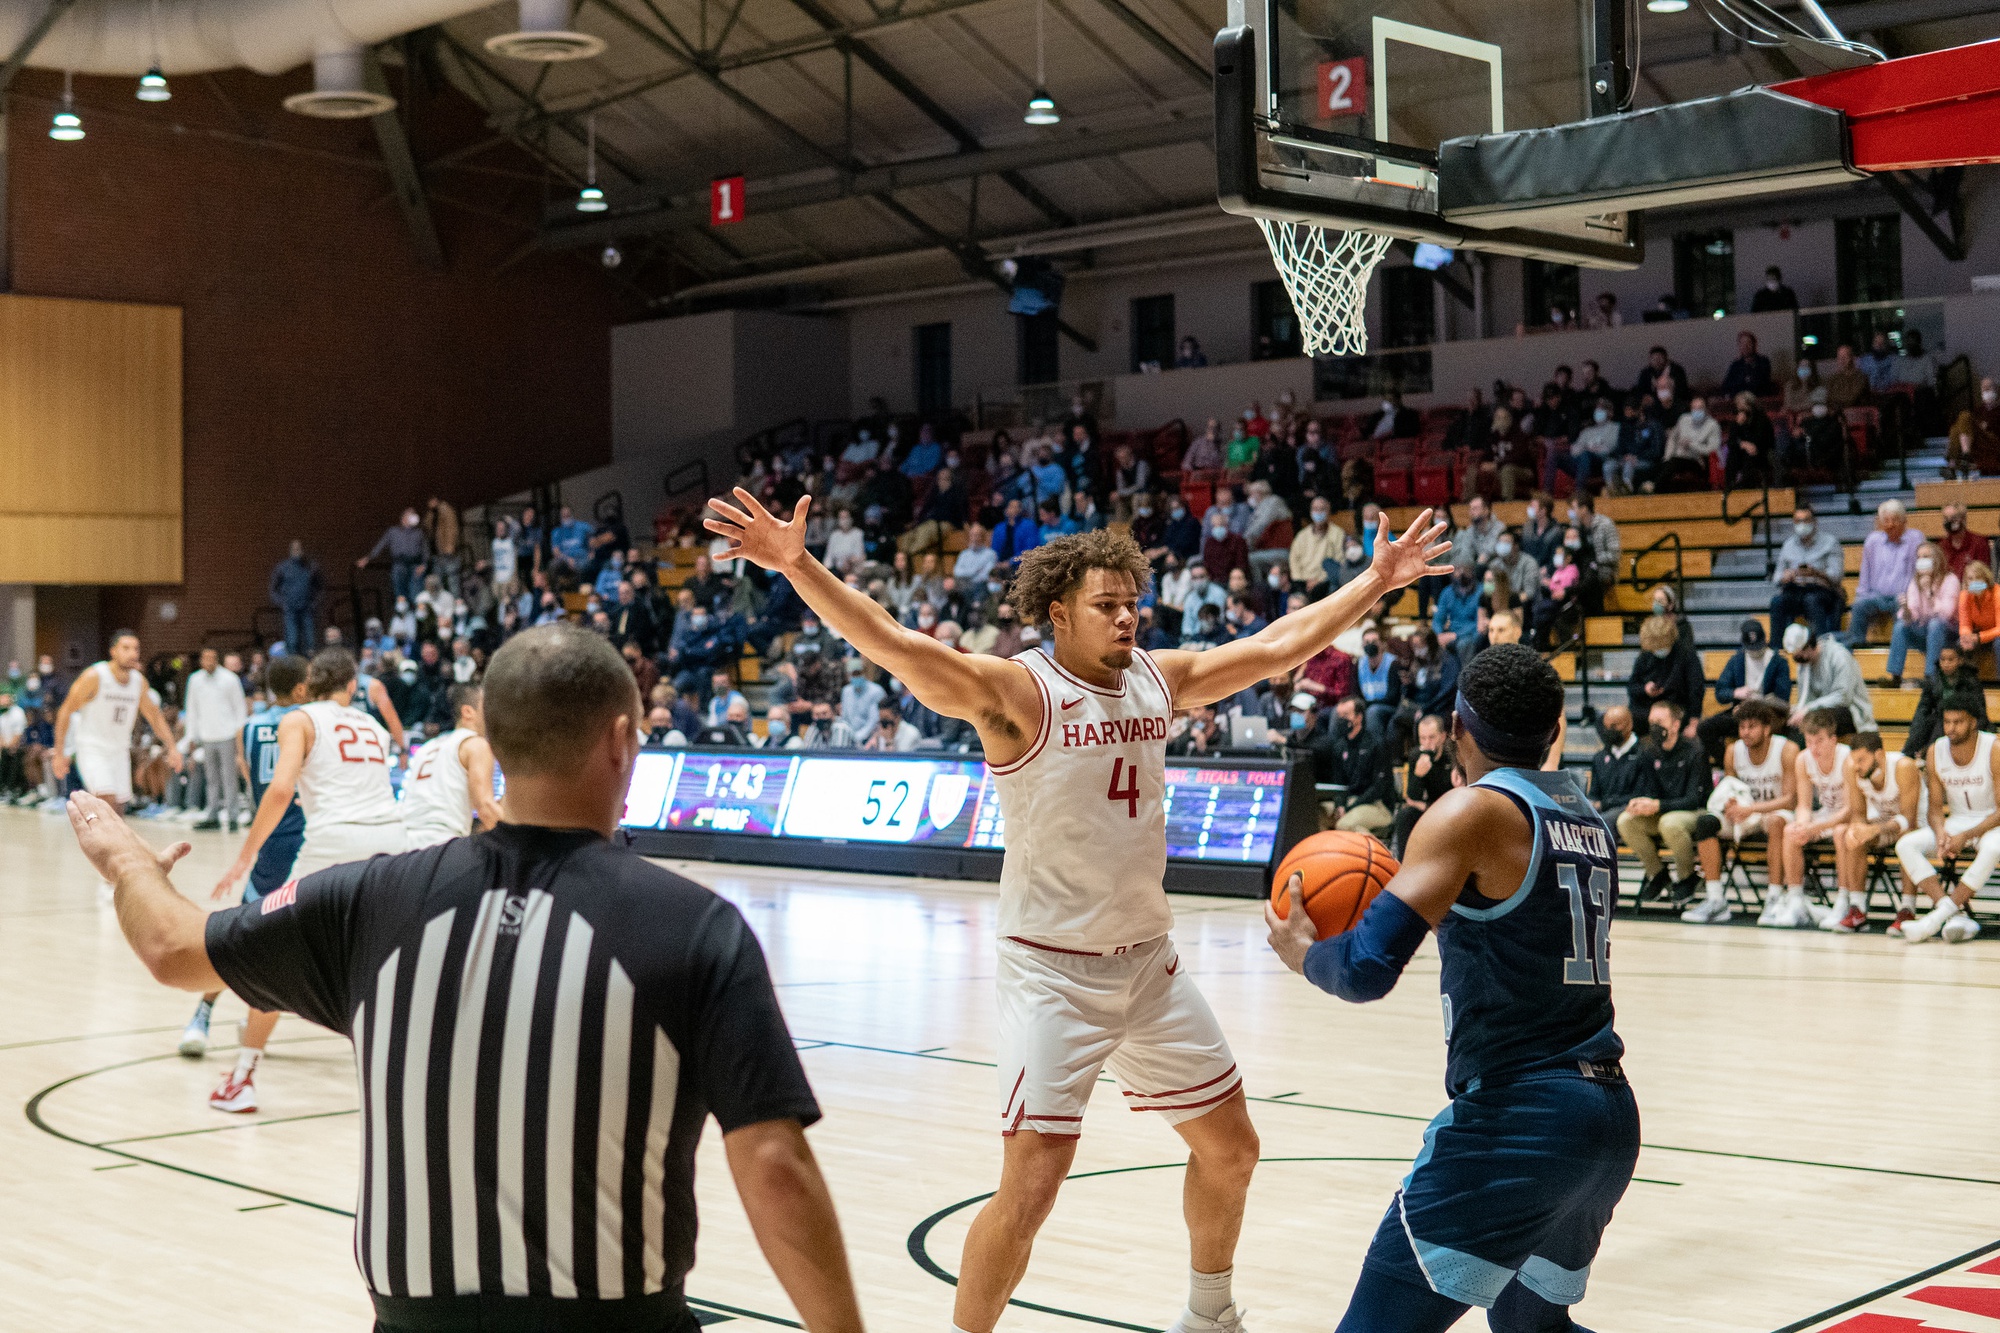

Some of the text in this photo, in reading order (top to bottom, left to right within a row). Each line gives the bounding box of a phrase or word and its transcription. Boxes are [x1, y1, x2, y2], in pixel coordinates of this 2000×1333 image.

[1329, 65, 1353, 110] 2
[718, 183, 733, 219] 1
[335, 724, 385, 764] 23
[1062, 717, 1167, 747] HARVARD
[705, 763, 767, 800] 1:43
[1107, 757, 1140, 818] 4
[1195, 770, 1239, 785] STEALS
[1942, 775, 1984, 788] ARVARD
[862, 780, 909, 826] 52
[1546, 820, 1610, 859] MARTIN
[1556, 863, 1612, 985] 12
